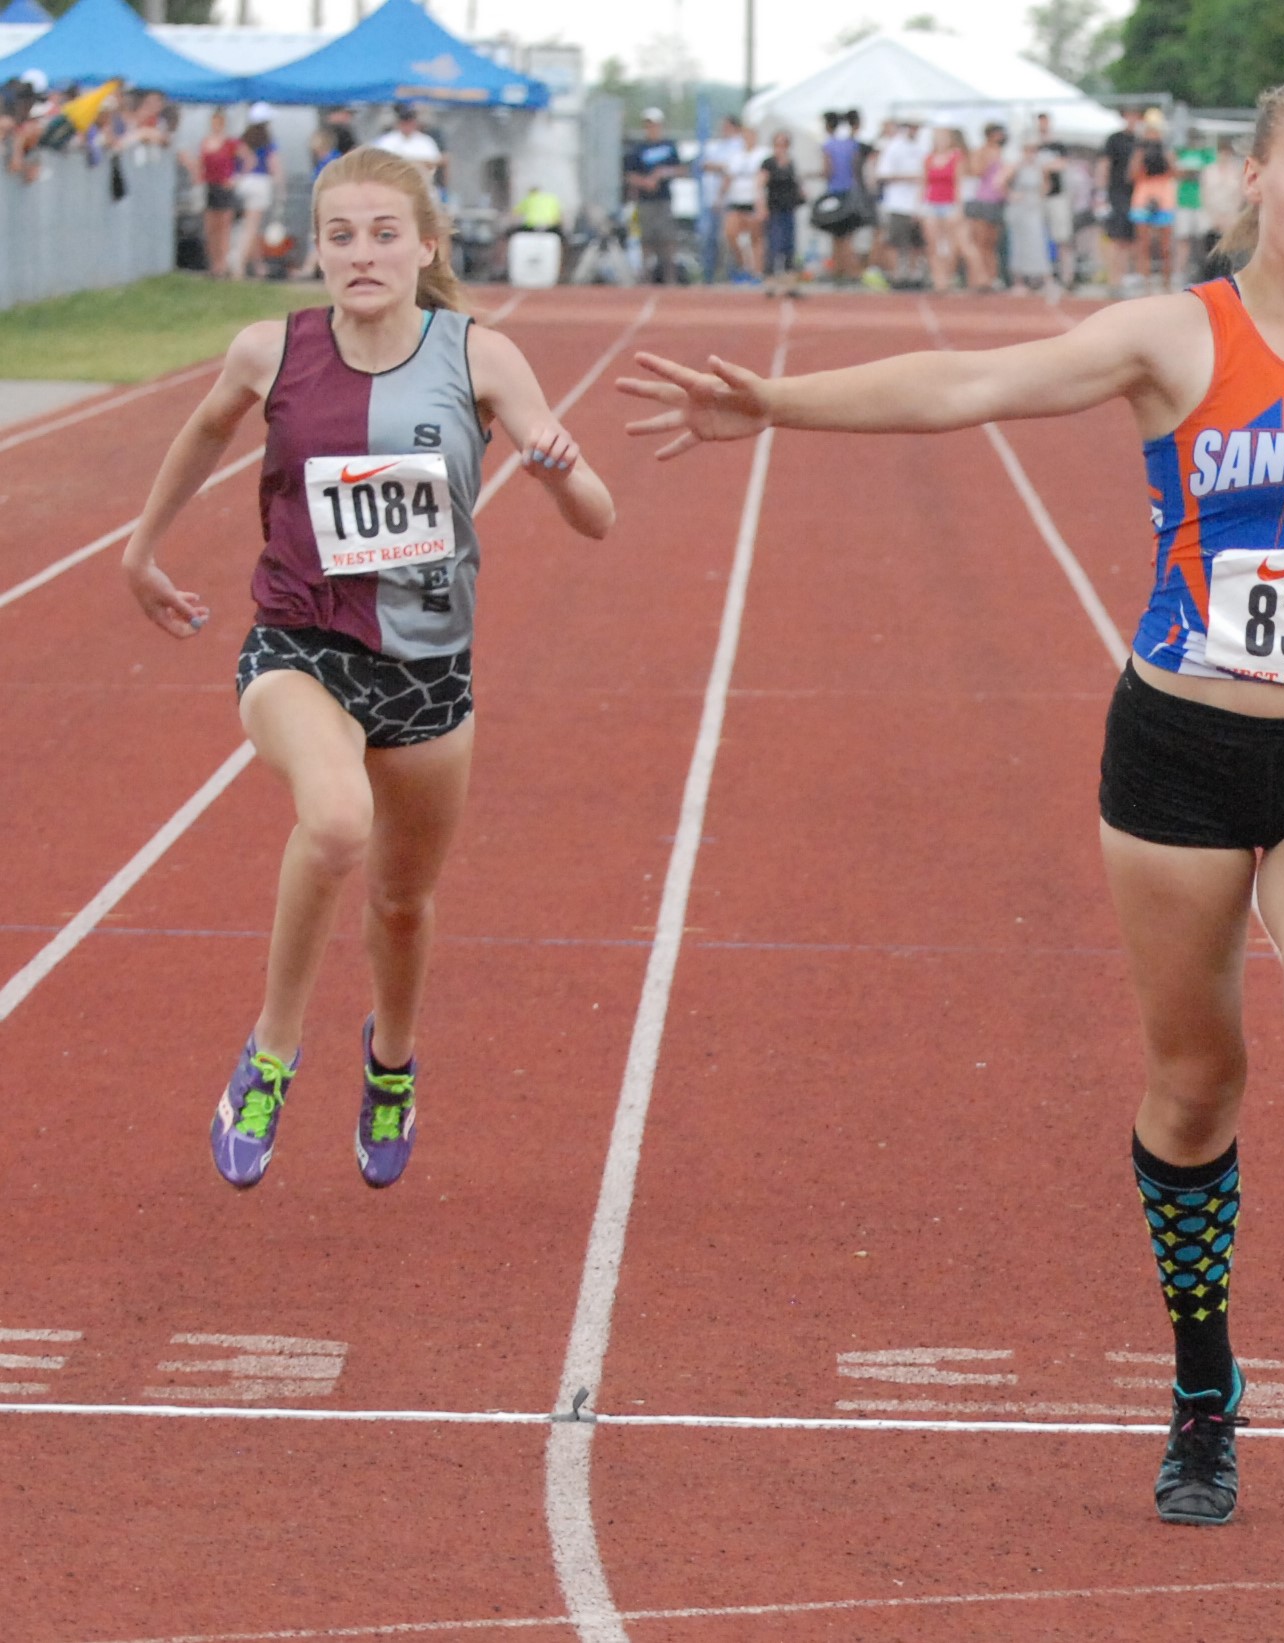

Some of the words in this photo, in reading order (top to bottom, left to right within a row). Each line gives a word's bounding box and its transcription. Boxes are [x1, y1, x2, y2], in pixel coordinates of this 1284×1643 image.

[323, 480, 440, 540] 1084
[333, 549, 376, 567] WEST
[381, 540, 445, 560] REGION
[1232, 669, 1278, 685] EST
